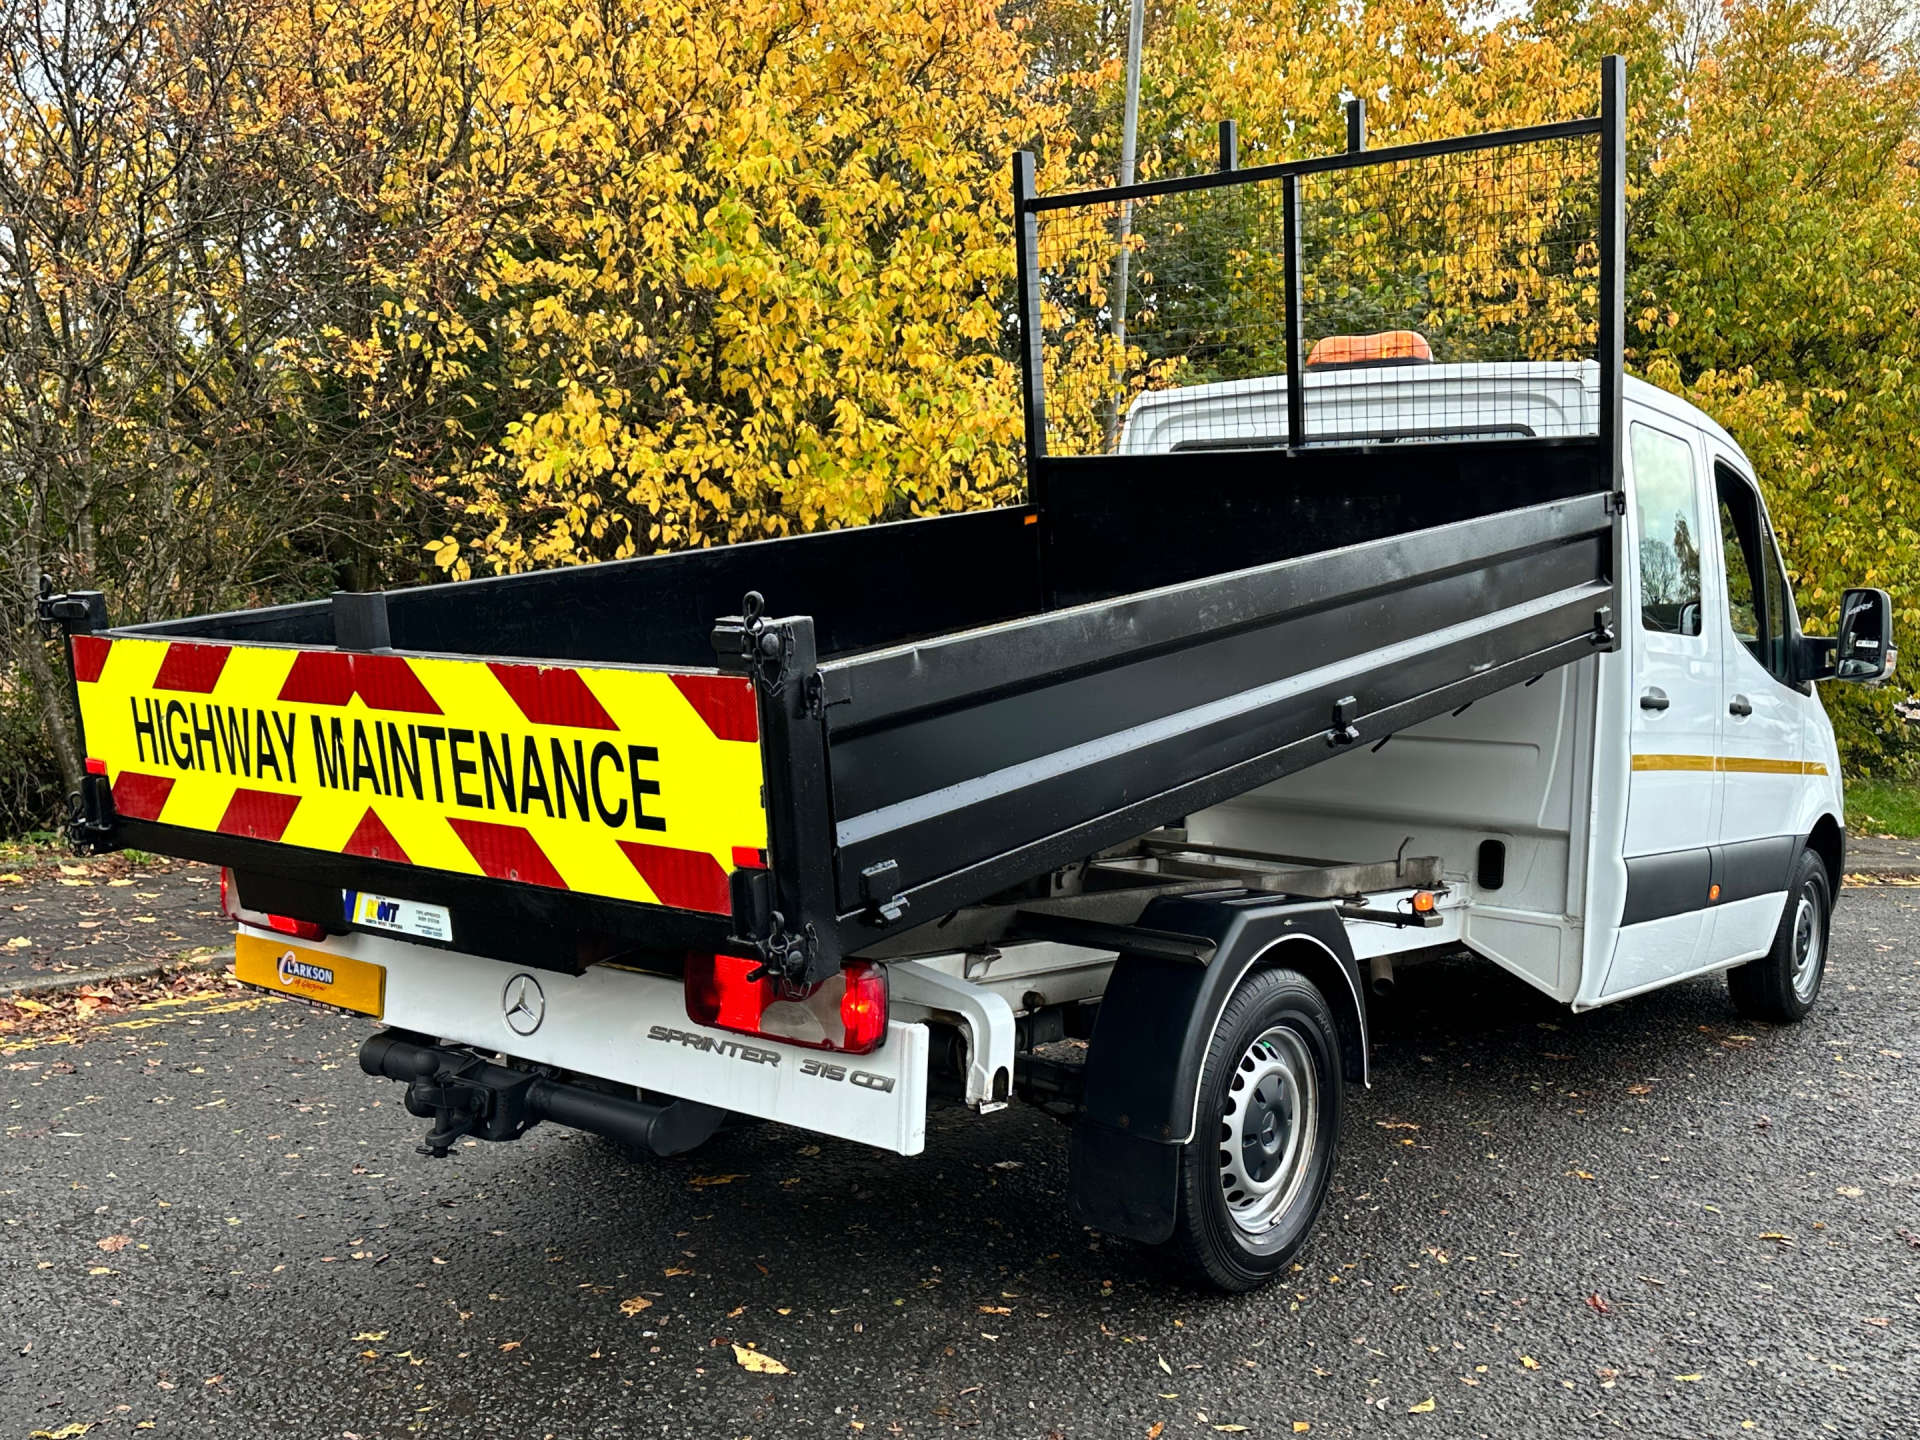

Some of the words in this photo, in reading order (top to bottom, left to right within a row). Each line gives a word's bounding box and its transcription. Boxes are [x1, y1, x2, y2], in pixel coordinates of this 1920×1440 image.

[130, 696, 296, 784] HIGHWAY
[310, 715, 667, 832] MAINTENANCE
[279, 950, 333, 985] CLARKSON
[647, 1025, 782, 1067] SPRINTER
[800, 1059, 847, 1082] 315
[850, 1070, 896, 1093] CDI
